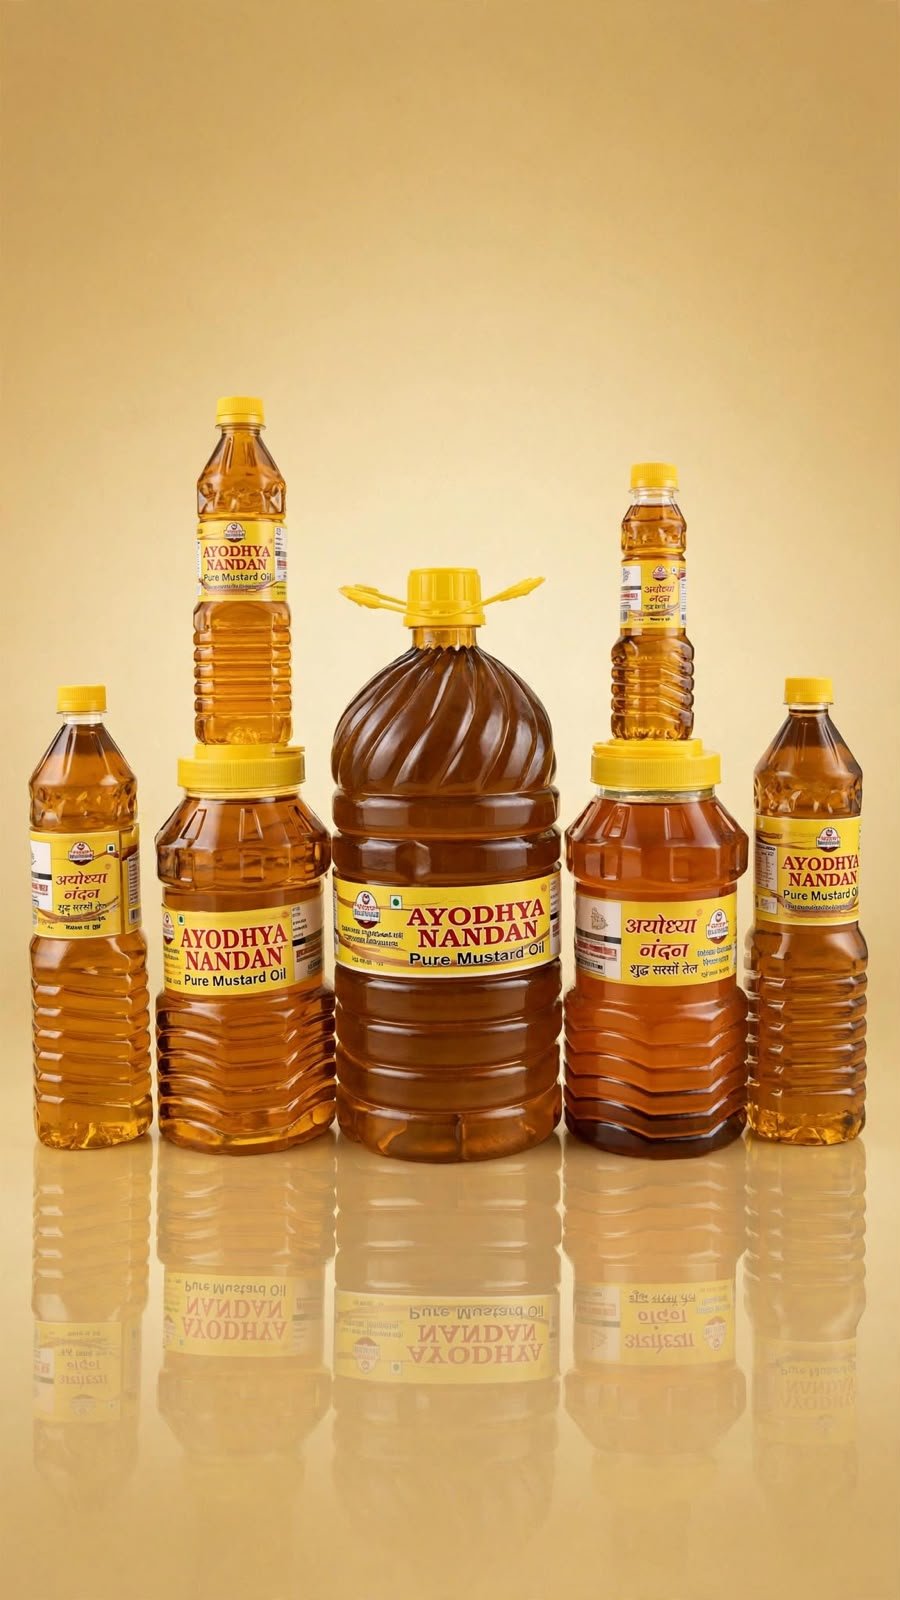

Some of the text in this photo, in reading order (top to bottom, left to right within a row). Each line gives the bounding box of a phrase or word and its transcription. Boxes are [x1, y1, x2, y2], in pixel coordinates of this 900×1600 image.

[203, 545, 271, 558] AYODHYA
[207, 559, 267, 570] NANDAN
[204, 572, 272, 582] Pure Mustard Oil
[782, 854, 859, 871] AYODHYA
[56, 871, 108, 885] अयोध्या
[788, 870, 858, 887] NANDAN
[64, 886, 100, 900] नंदन
[783, 890, 808, 900] Pure
[811, 890, 850, 901] Mustard
[407, 898, 545, 926] AYODHYA
[626, 914, 698, 934] अयोध्या
[181, 924, 288, 949] AYODHYA
[418, 920, 538, 948] NANDAN
[409, 941, 544, 966] Pure Mustard Oil
[640, 938, 690, 960] नंदन
[186, 946, 284, 972] NANDAN
[184, 974, 209, 986] Pure
[213, 972, 266, 986] Mustard
[270, 968, 286, 981] Oil
[630, 964, 650, 978] शुद्ध
[653, 962, 680, 975] सरसों
[682, 962, 698, 975] तेल
